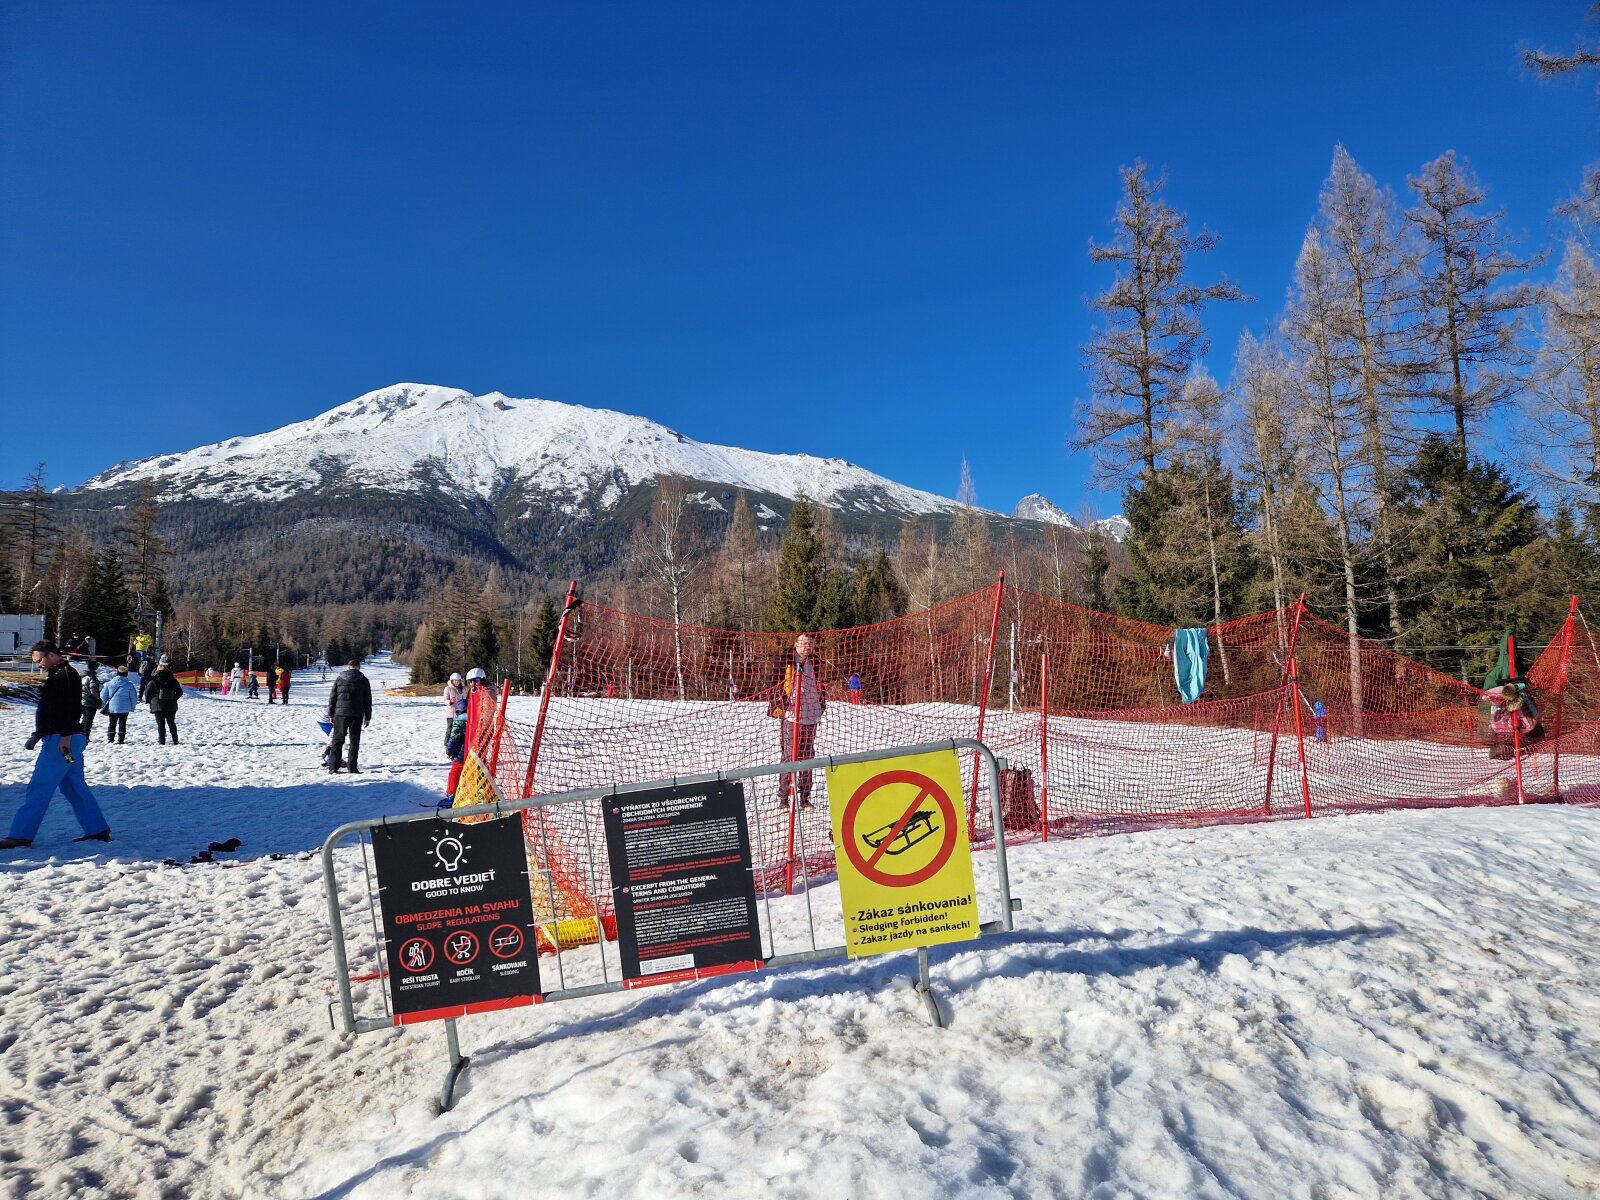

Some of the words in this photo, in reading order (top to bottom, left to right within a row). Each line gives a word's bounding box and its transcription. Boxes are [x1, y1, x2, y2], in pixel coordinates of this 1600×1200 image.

[660, 796, 707, 806] VŠEOBECNÝCH
[622, 807, 666, 818] OBCHODNÝCH
[666, 802, 703, 812] PODMIENOK
[412, 877, 451, 891] DOBRE
[453, 869, 496, 885] VEDIEŤ
[631, 882, 658, 892] EXCERPT
[690, 874, 718, 883] GENERAL
[426, 889, 448, 898] GOOD
[460, 884, 484, 893] KNOW
[632, 890, 652, 898] TERMS
[668, 882, 706, 892] CONDITIONS
[395, 908, 463, 924] OBMEDZENIA
[465, 905, 480, 915] NA
[482, 899, 519, 912] SVAHU
[858, 908, 894, 921] Zákaz
[898, 894, 972, 914] sánkovania!
[417, 922, 442, 931] SLOPE
[446, 913, 500, 927] REGULATIONS
[859, 920, 898, 933] Sledging
[901, 912, 948, 926] forbidden!
[861, 933, 887, 944] Zakaz
[890, 929, 913, 942] jazdy
[930, 921, 970, 933] sankach!
[456, 968, 474, 977] KOČÍK
[492, 960, 527, 971] SÁNKOVANIE
[400, 982, 424, 991] PEDESTRIAN
[402, 976, 415, 985] PEŠÍ
[416, 974, 438, 982] TURISTA
